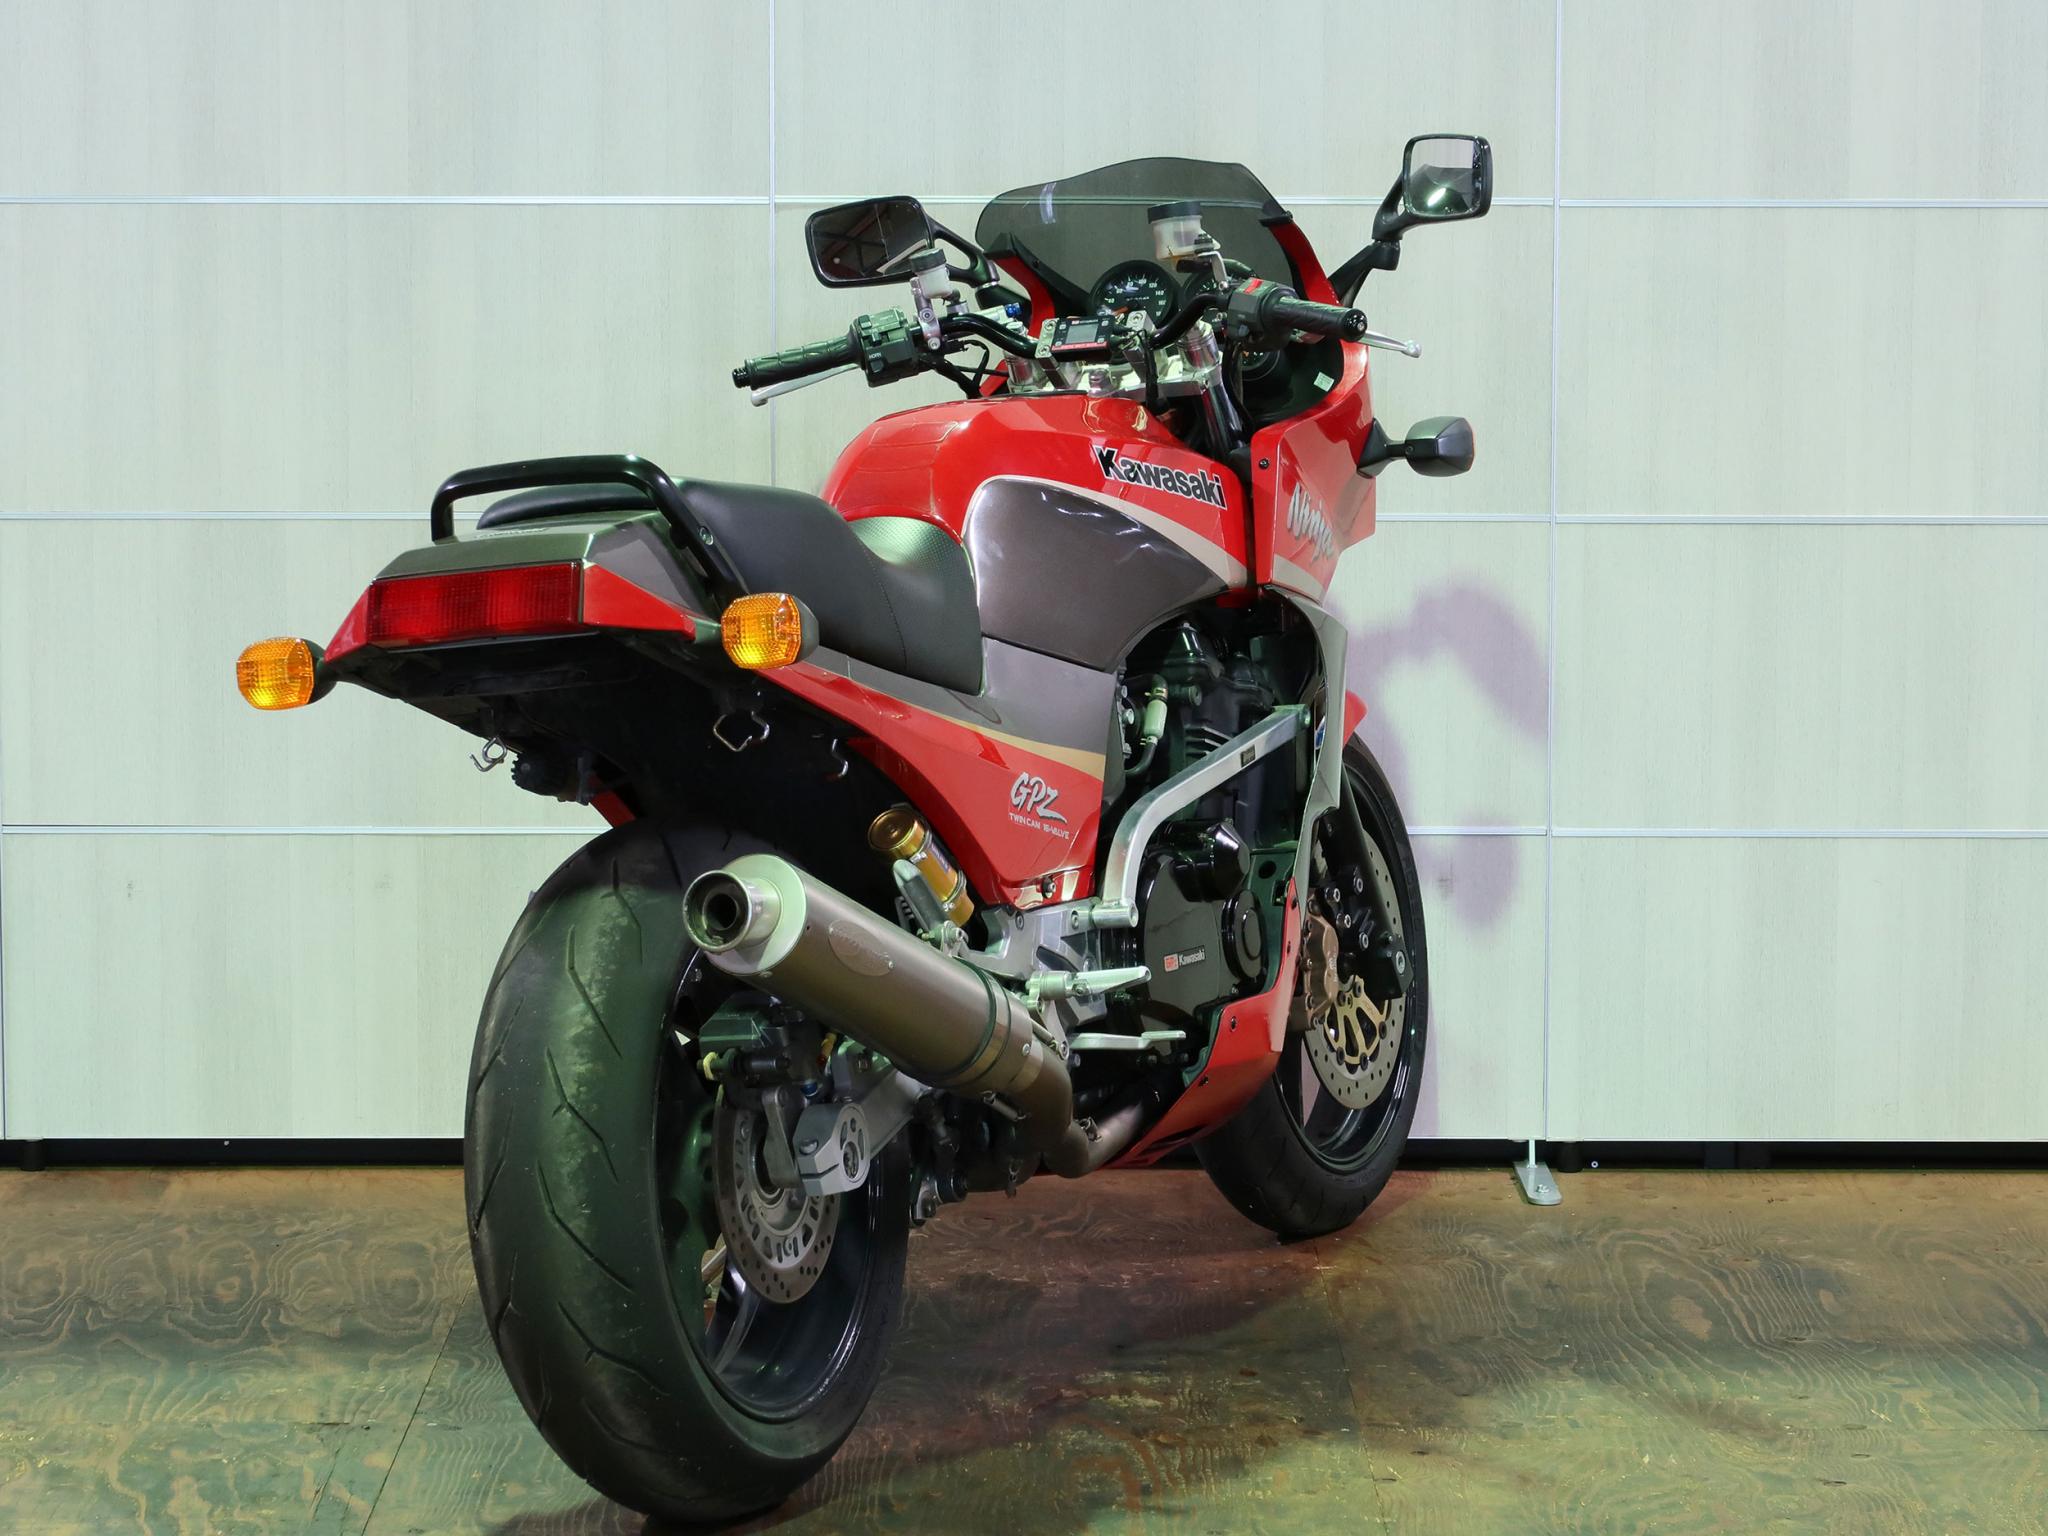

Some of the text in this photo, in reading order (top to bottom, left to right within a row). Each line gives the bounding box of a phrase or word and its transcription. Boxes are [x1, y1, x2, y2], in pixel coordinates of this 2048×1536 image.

[1093, 445, 1227, 510] Kawasaki
[1286, 481, 1333, 566] Ninja
[1009, 812, 1026, 825] TWIN
[1027, 818, 1041, 830] CAM
